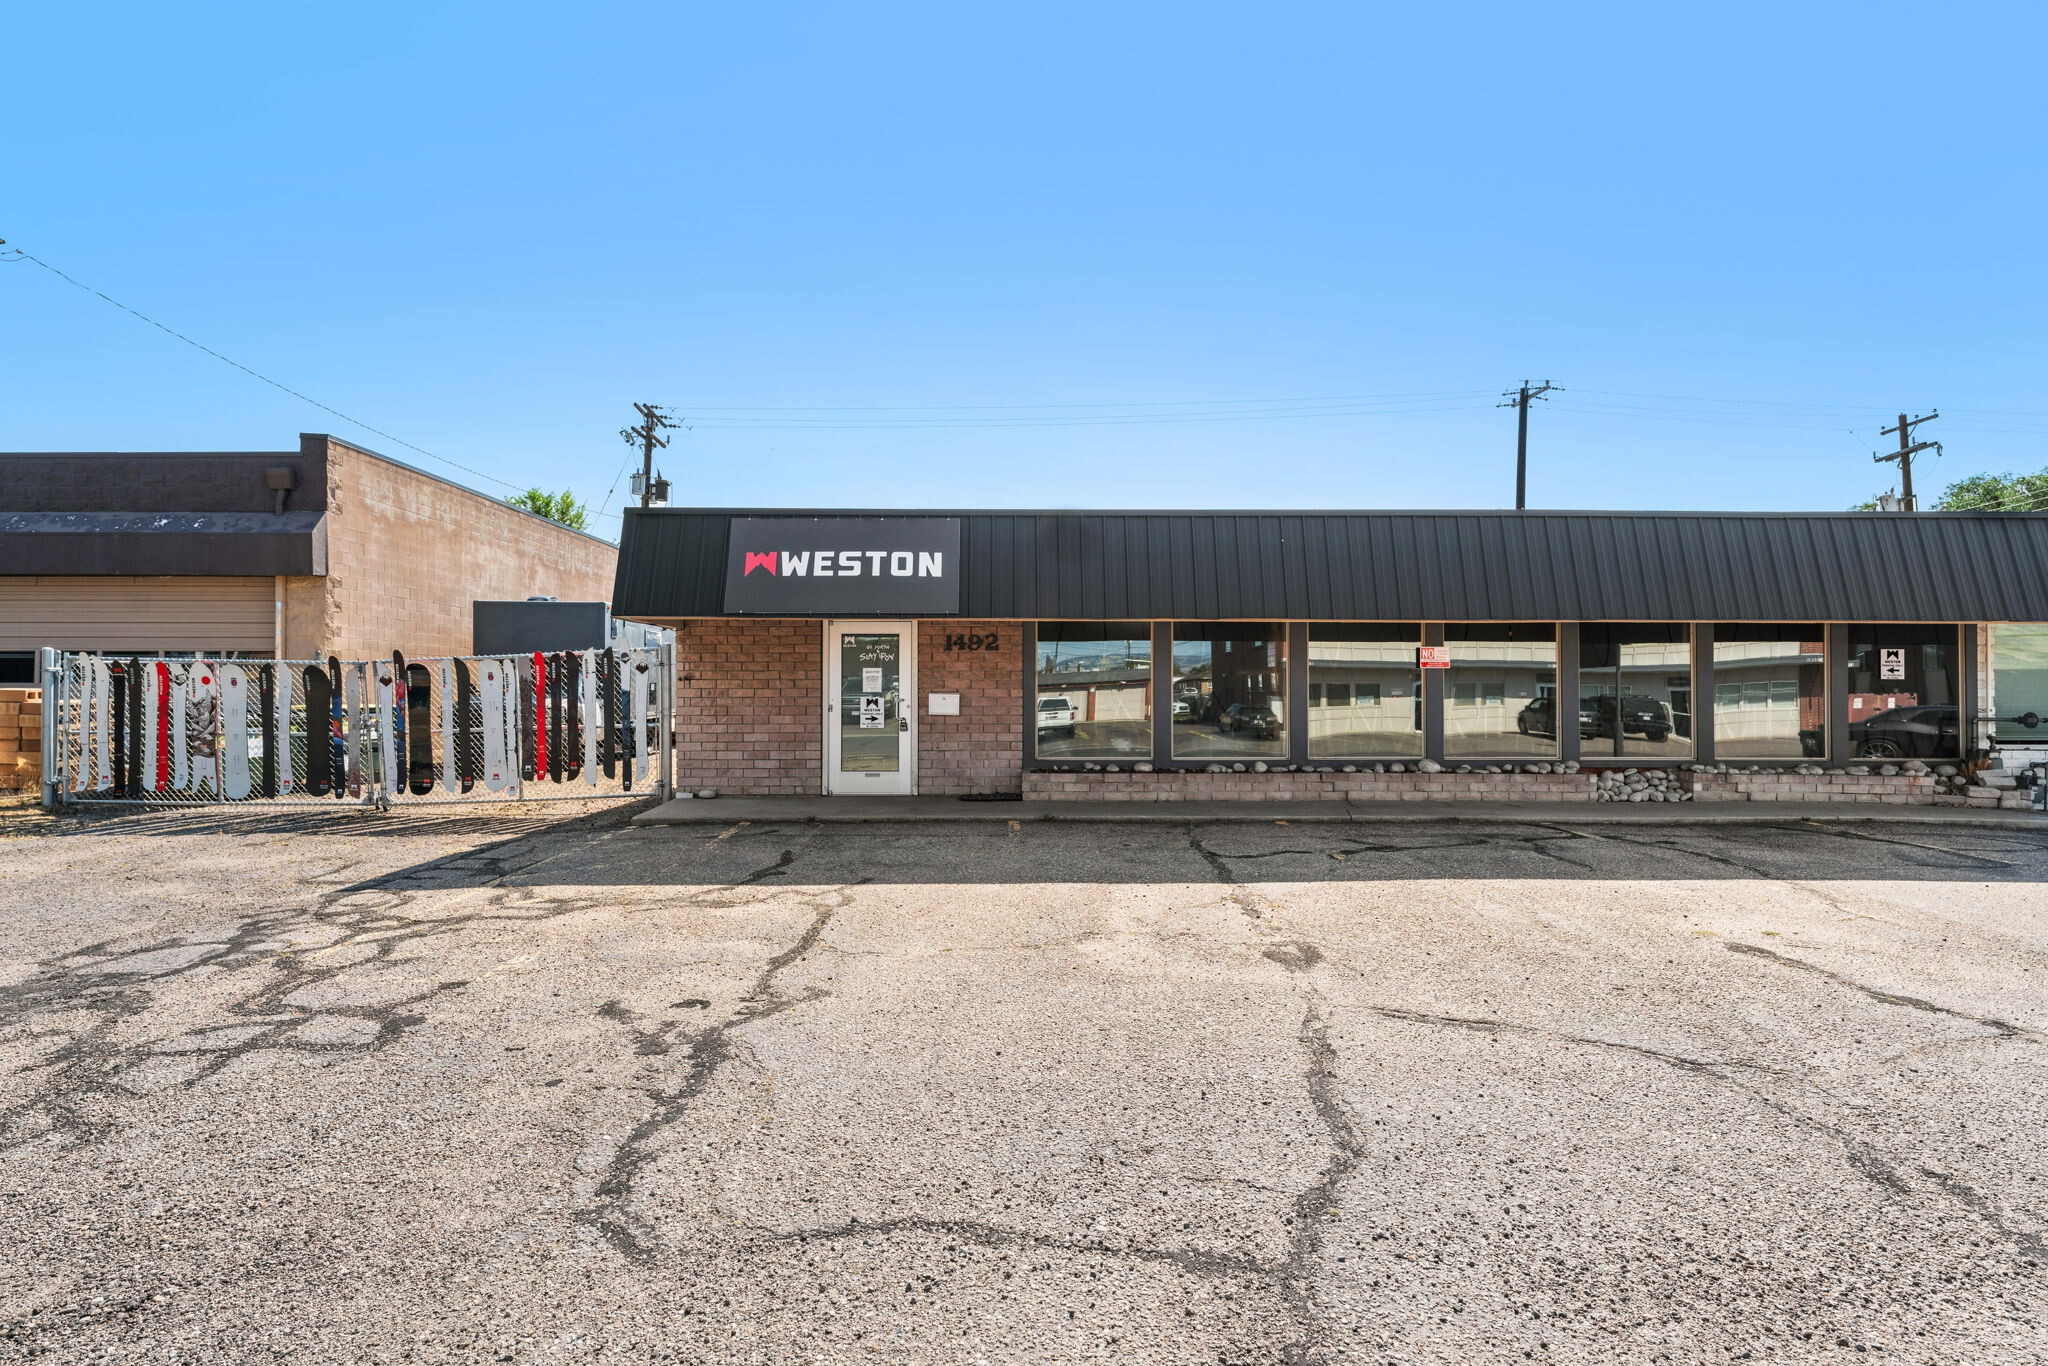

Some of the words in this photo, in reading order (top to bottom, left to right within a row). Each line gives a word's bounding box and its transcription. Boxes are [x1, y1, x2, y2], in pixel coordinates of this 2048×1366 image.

[781, 551, 943, 578] WESTON
[945, 633, 999, 652] 1492
[859, 652, 878, 662] SLAY
[1422, 649, 1434, 659] NO
